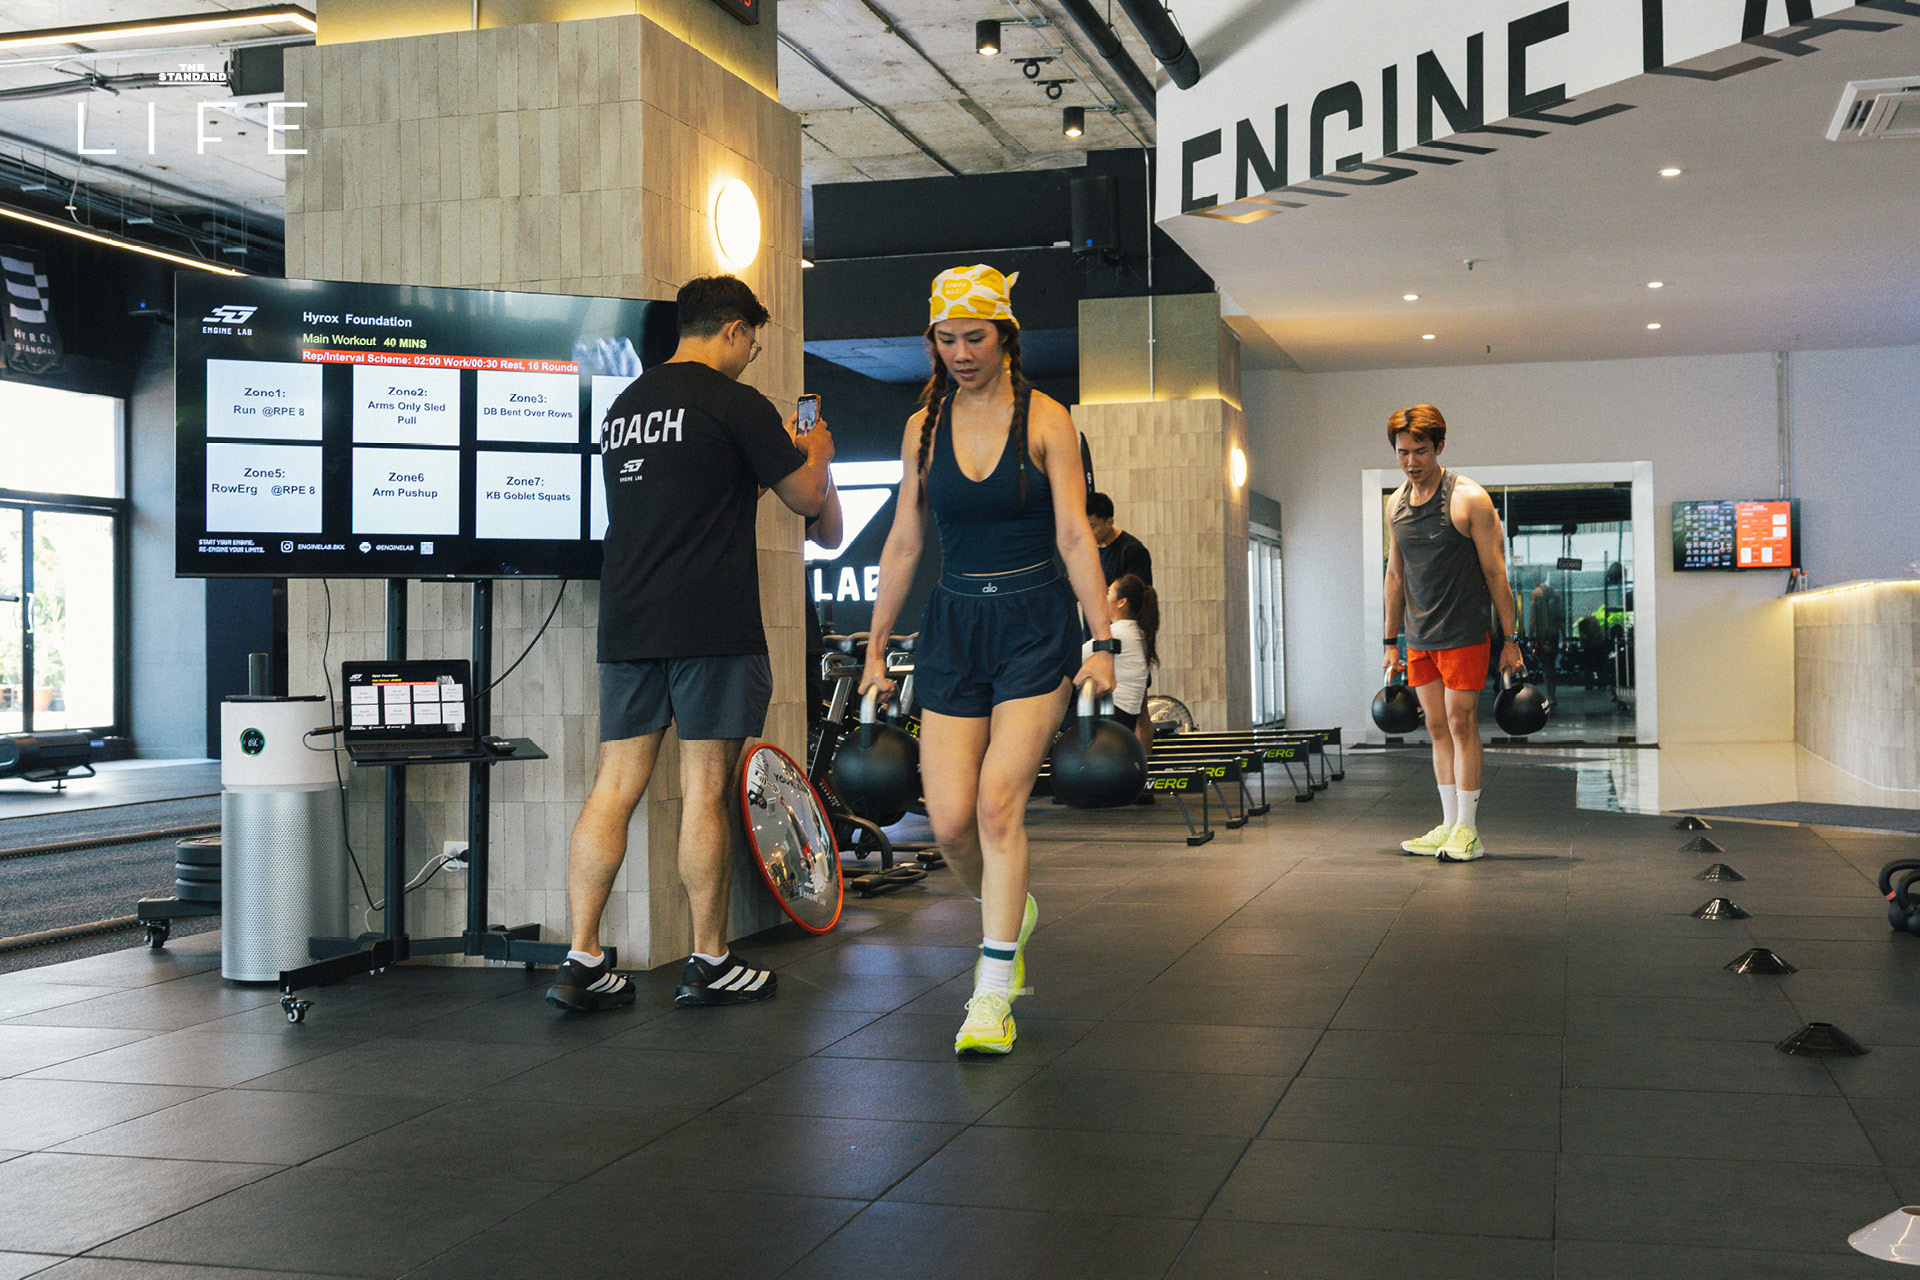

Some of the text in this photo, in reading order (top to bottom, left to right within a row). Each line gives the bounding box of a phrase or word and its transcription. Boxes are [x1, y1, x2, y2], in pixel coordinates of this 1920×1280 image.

[1182, 0, 1638, 224] ENGINE
[303, 312, 412, 328] Hyrox Foundation
[202, 326, 253, 336] ENGINE LAB
[303, 333, 427, 349] Main Workout 40 MINS
[302, 351, 578, 372] Rep/Interval Scheme: 02:00 Work/00:30 Rest, 16 Rounds
[244, 388, 286, 398] Zone1:
[388, 386, 428, 397] Zone2:
[509, 393, 547, 404] Zone3:
[233, 405, 305, 417] Run @RPE 8
[368, 401, 446, 413] Arms Only Sled
[483, 407, 573, 419] DB Bent Over Rows
[397, 415, 417, 425] Pull
[600, 408, 685, 455] COACH
[244, 468, 286, 479] Zone5:
[388, 472, 425, 483] Zone6
[506, 476, 545, 487] Zone7:
[211, 483, 316, 496] RowErg @RPE 8
[372, 488, 438, 499] Arm Pushup
[486, 491, 571, 502] KB Goblet Squats
